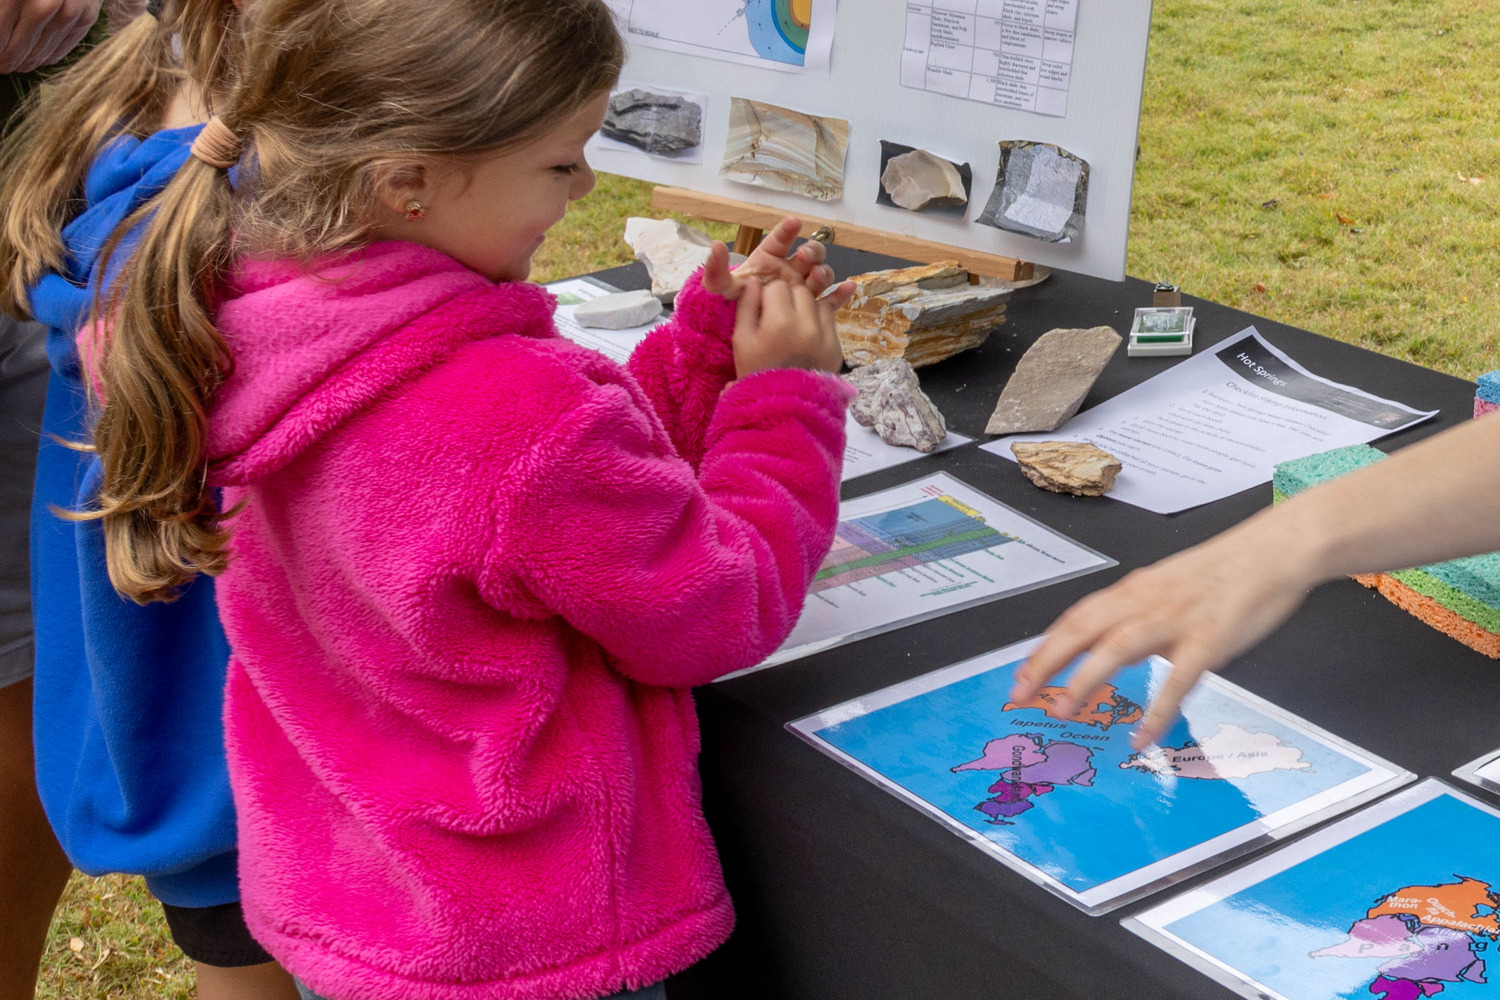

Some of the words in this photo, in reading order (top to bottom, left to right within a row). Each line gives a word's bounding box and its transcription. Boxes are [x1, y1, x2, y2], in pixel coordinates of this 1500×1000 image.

[1236, 352, 1256, 370] Hot
[1252, 364, 1288, 388] Springs
[1010, 718, 1068, 729] Iapetus
[1060, 731, 1111, 742] Ocean
[1172, 754, 1224, 763] Europe
[1237, 750, 1269, 759] Asia
[1387, 896, 1423, 905] Mara-
[1389, 901, 1419, 909] thon
